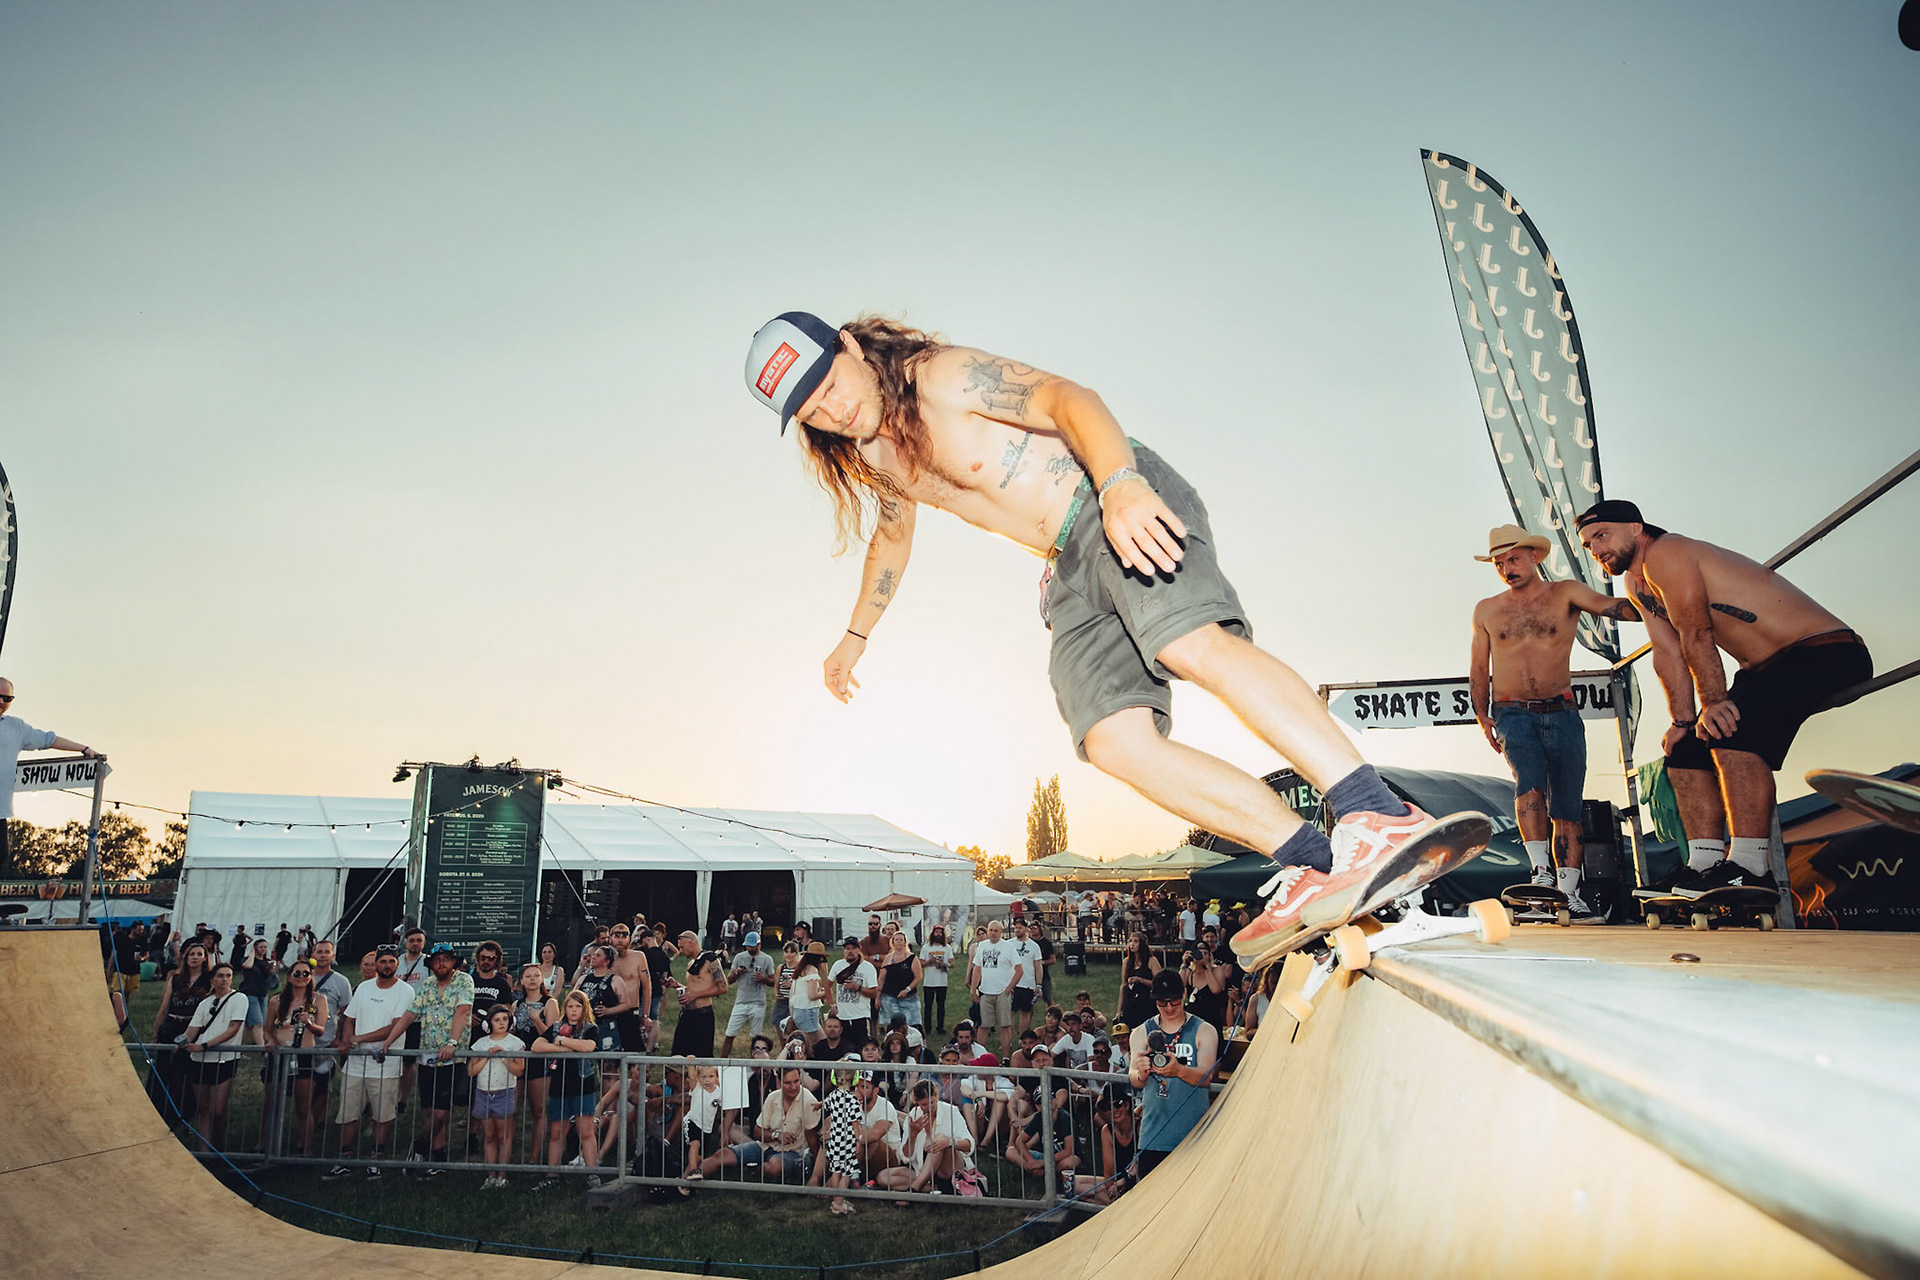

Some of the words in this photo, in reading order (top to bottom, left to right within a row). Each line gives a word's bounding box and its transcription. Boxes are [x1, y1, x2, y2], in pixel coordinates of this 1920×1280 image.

[1354, 690, 1441, 721] SKATE
[1573, 682, 1614, 711] OW
[21, 763, 61, 785] SHOW
[65, 762, 98, 782] NOW
[462, 784, 512, 798] JAMESON
[0, 884, 35, 896] BEER
[119, 883, 151, 895] BEER
